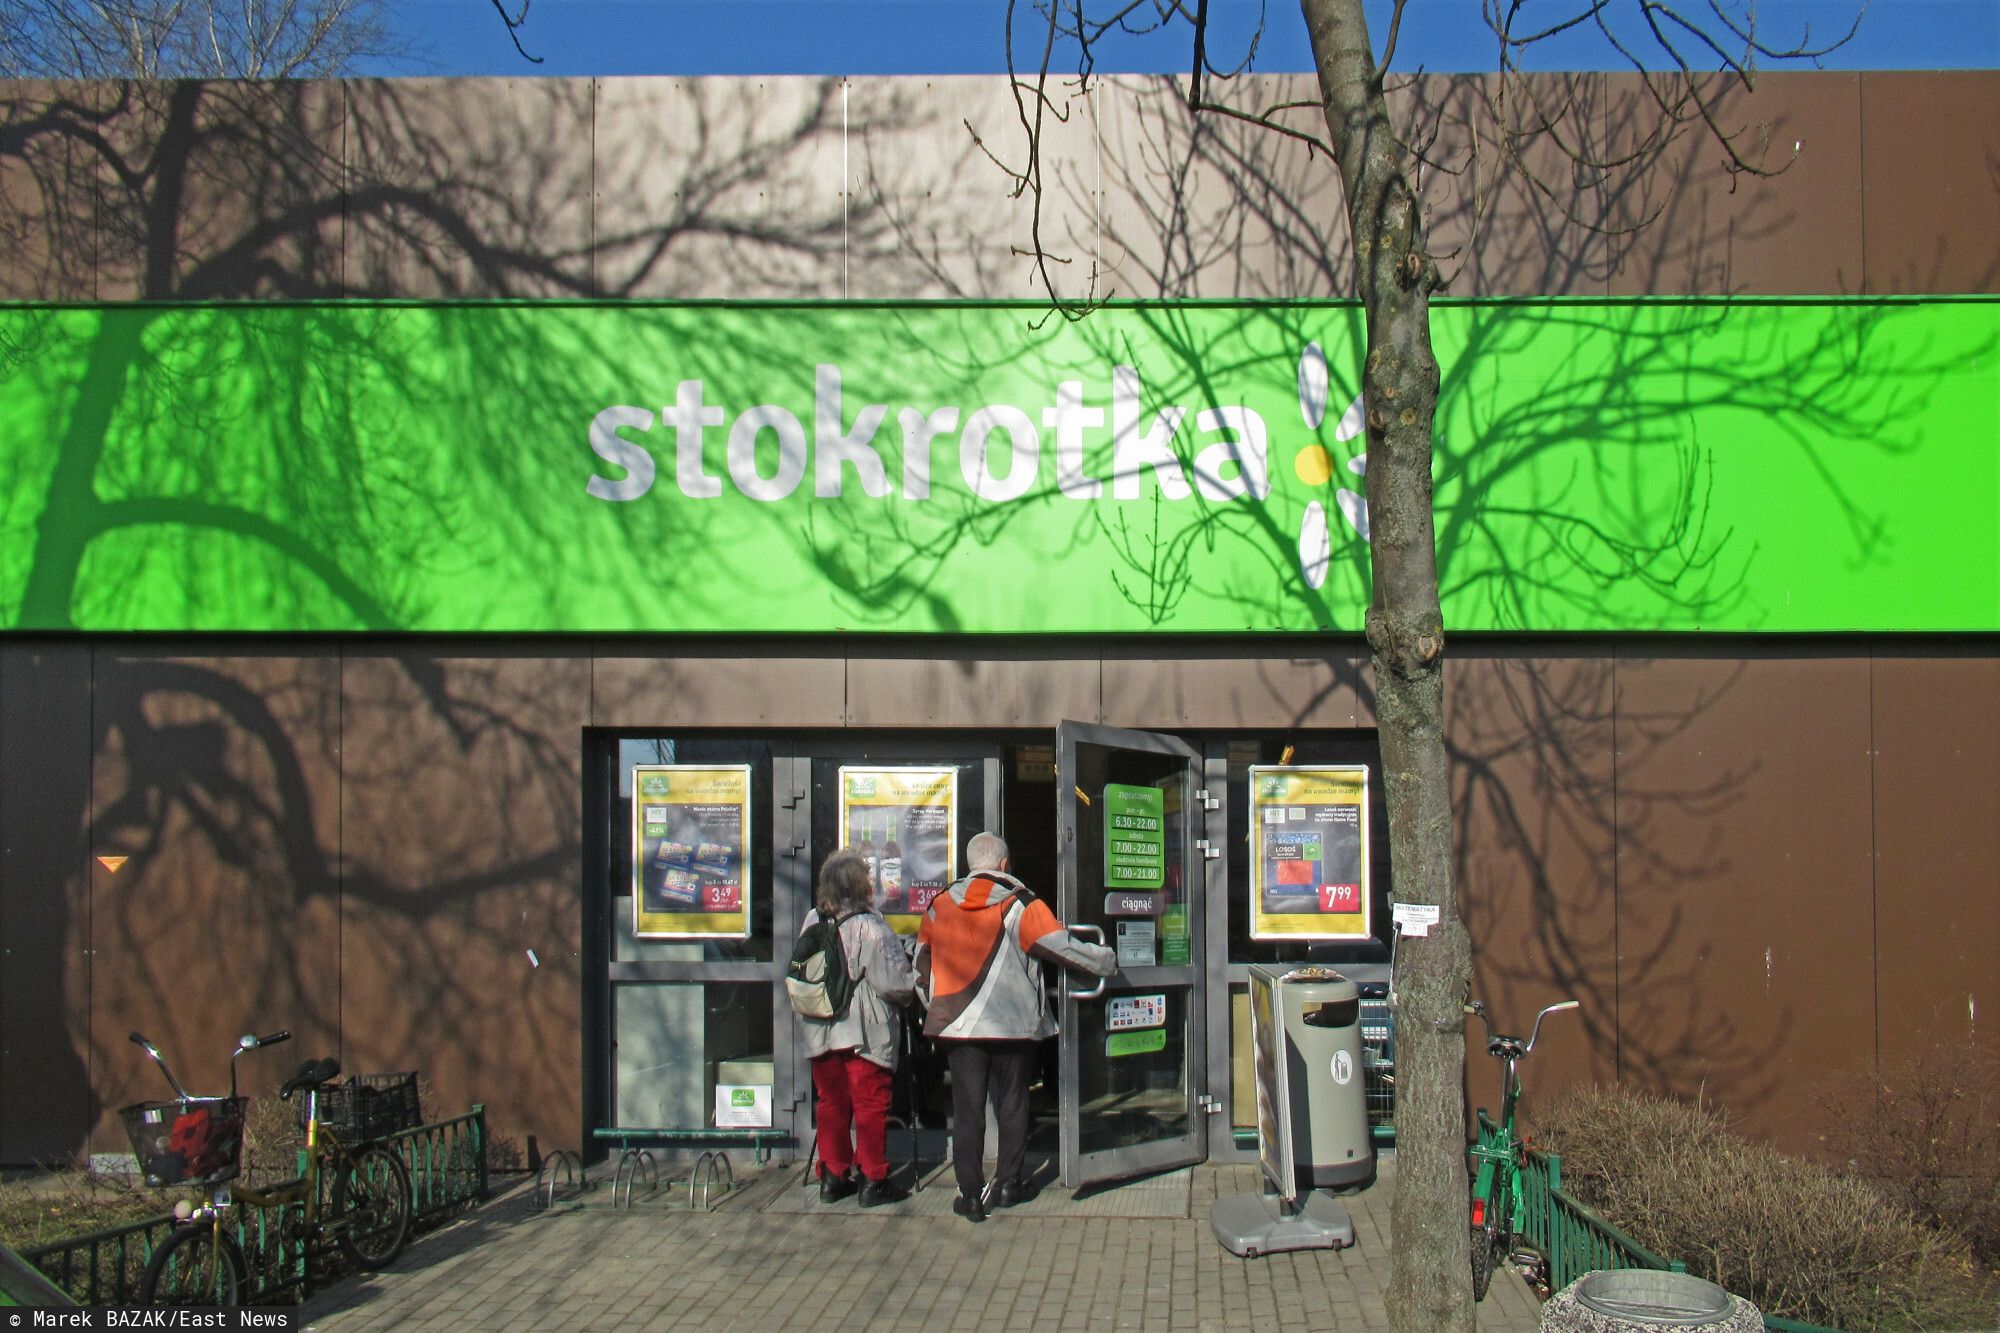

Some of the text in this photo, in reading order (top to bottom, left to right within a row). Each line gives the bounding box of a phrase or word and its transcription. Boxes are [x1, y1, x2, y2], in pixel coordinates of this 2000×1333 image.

[586, 364, 1271, 501] stokrotka
[1115, 816, 1132, 828] 6.30
[1136, 818, 1157, 830] 22.00
[1116, 842, 1132, 853] 7.00
[1137, 843, 1157, 854] 22.00
[1116, 867, 1132, 878] 7.00
[1137, 868, 1157, 879] 21.00
[1121, 896, 1152, 911] ciągnąć
